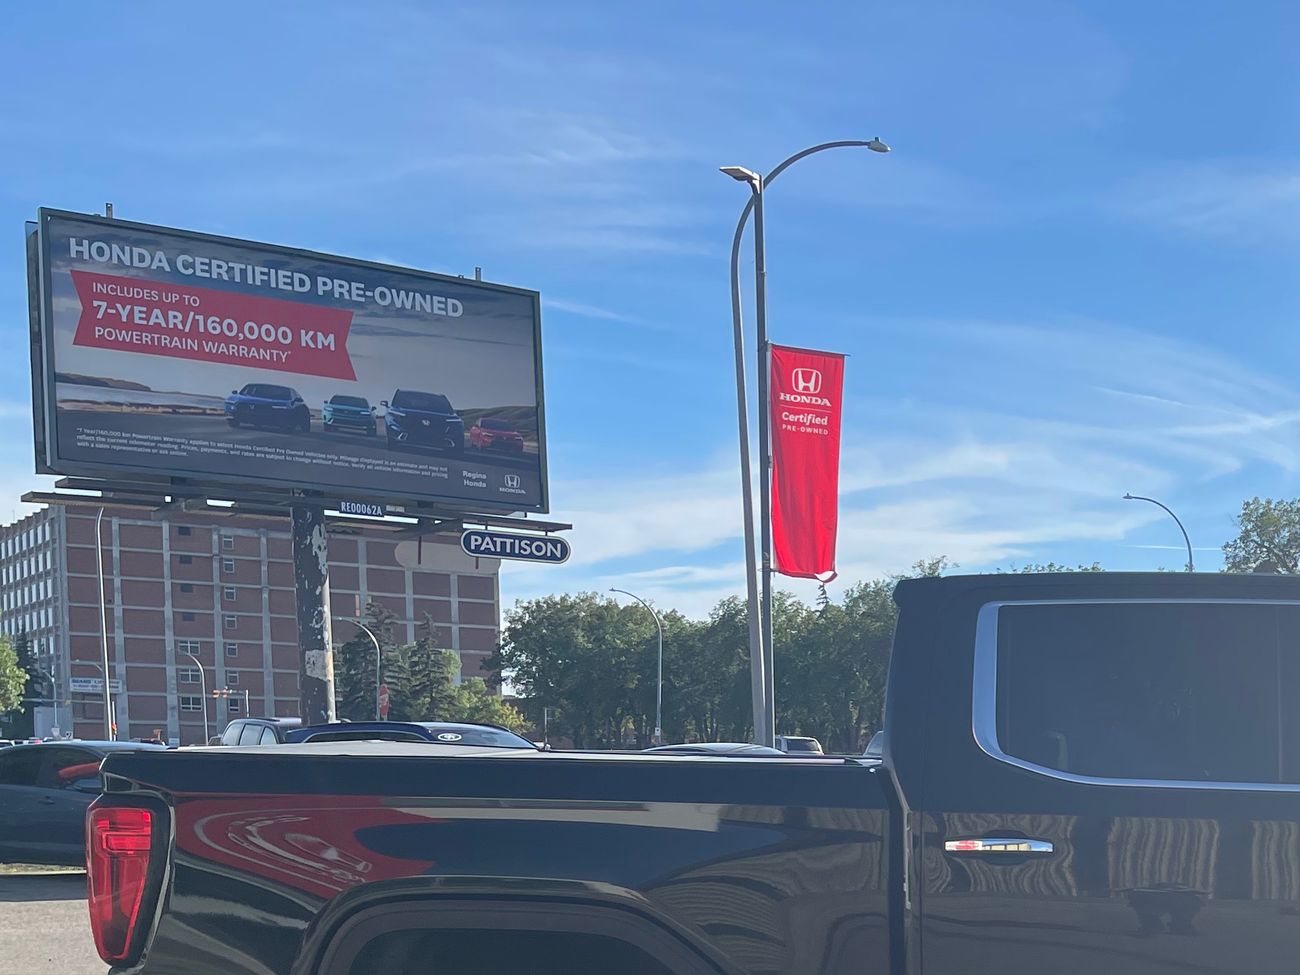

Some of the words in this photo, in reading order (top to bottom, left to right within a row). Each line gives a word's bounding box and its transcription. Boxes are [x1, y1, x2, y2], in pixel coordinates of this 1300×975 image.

[69, 237, 170, 272] HONDA
[176, 254, 311, 293] CERTIFIED
[317, 276, 464, 318] PRE-OWNED
[92, 282, 159, 301] INCLUDES
[162, 292, 180, 303] UP
[182, 294, 200, 307] TO
[92, 300, 293, 345] 7-YEAR/160,000
[300, 329, 335, 351] KM
[95, 326, 198, 351] POWERTRAIN
[780, 392, 831, 406] HONDA
[782, 411, 828, 426] Certified
[782, 424, 828, 435] PRE-OWNED
[463, 480, 487, 488] Honda
[340, 502, 382, 516] RE00062A
[470, 534, 562, 559] PATTISON
